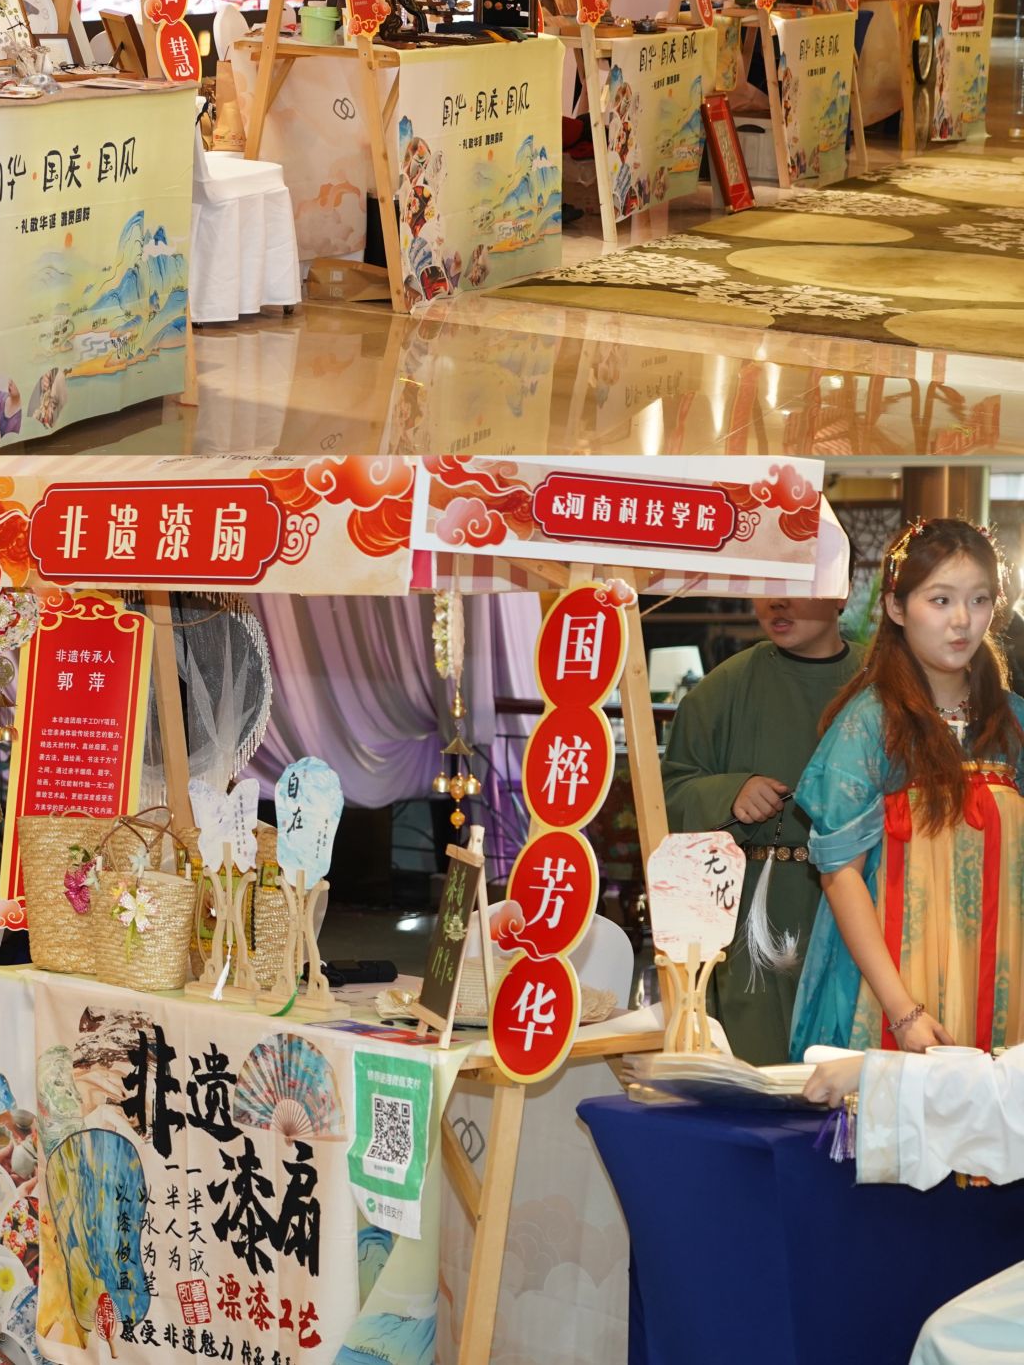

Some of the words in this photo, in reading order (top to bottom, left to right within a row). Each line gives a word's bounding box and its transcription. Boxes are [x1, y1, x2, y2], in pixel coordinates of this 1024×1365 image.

[56, 503, 248, 563] 非遗漆扇
[552, 492, 719, 532] &河南科技学院
[55, 649, 115, 664] 非遗传承人
[286, 771, 304, 834] 自在
[507, 611, 607, 1052] 国粹芳华
[704, 849, 735, 911] 无忧
[121, 1023, 244, 1158] 非遗
[137, 1184, 161, 1298] 以水为笔
[163, 1163, 182, 1272] 一半人为
[184, 1166, 210, 1278] 一半天成
[207, 1137, 321, 1278] 漆扇
[216, 1273, 322, 1349] 漂漆工艺
